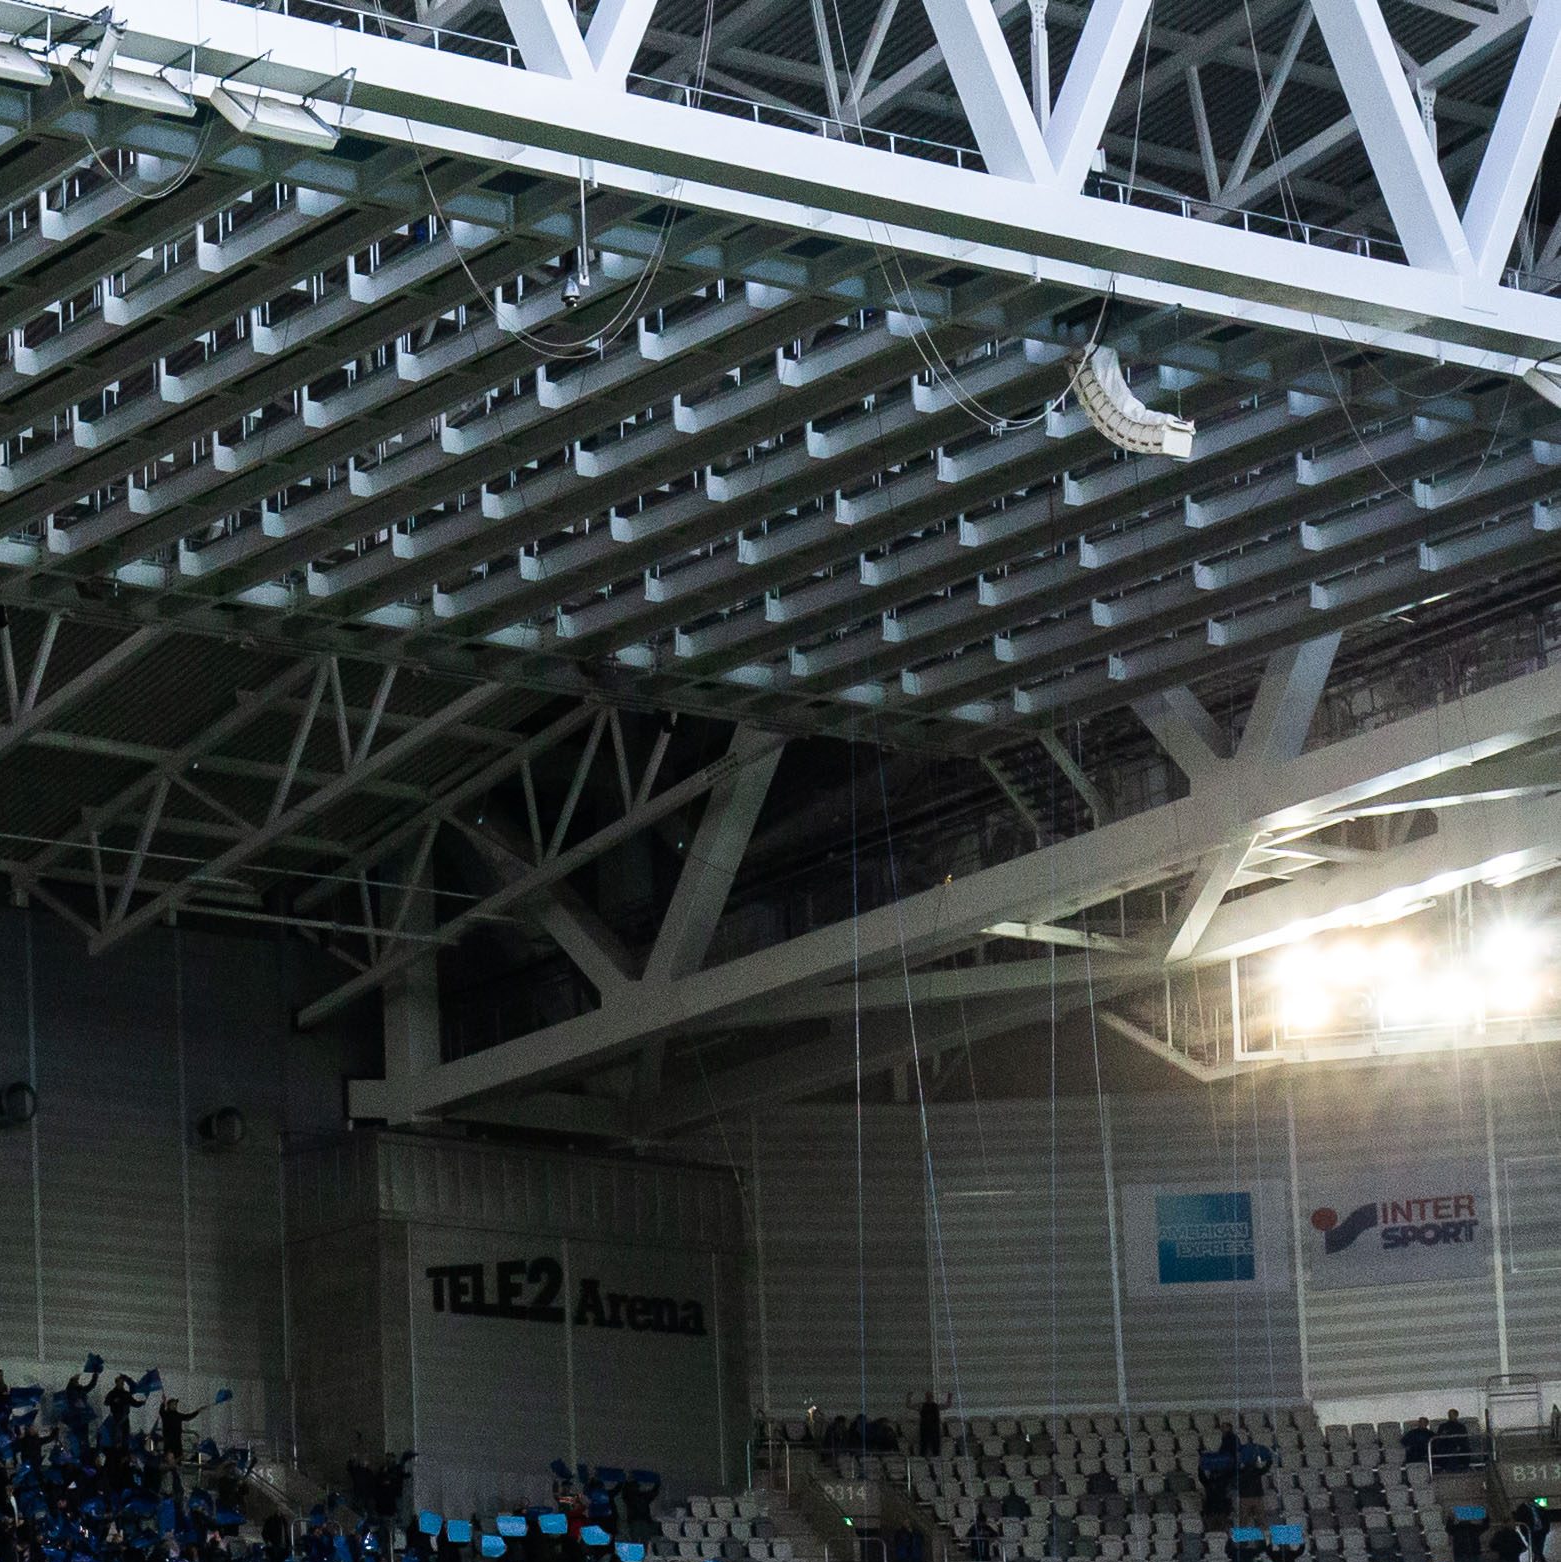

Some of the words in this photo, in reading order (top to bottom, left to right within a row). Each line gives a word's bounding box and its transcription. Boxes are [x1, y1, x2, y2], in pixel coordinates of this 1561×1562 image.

[1381, 1194, 1476, 1224] INTER
[1158, 1222, 1251, 1241] AMERICAN
[1382, 1219, 1478, 1250] SPORT
[1178, 1240, 1255, 1257] EXPRESS
[426, 1256, 566, 1323] TELE2
[575, 1278, 708, 1336] Arena
